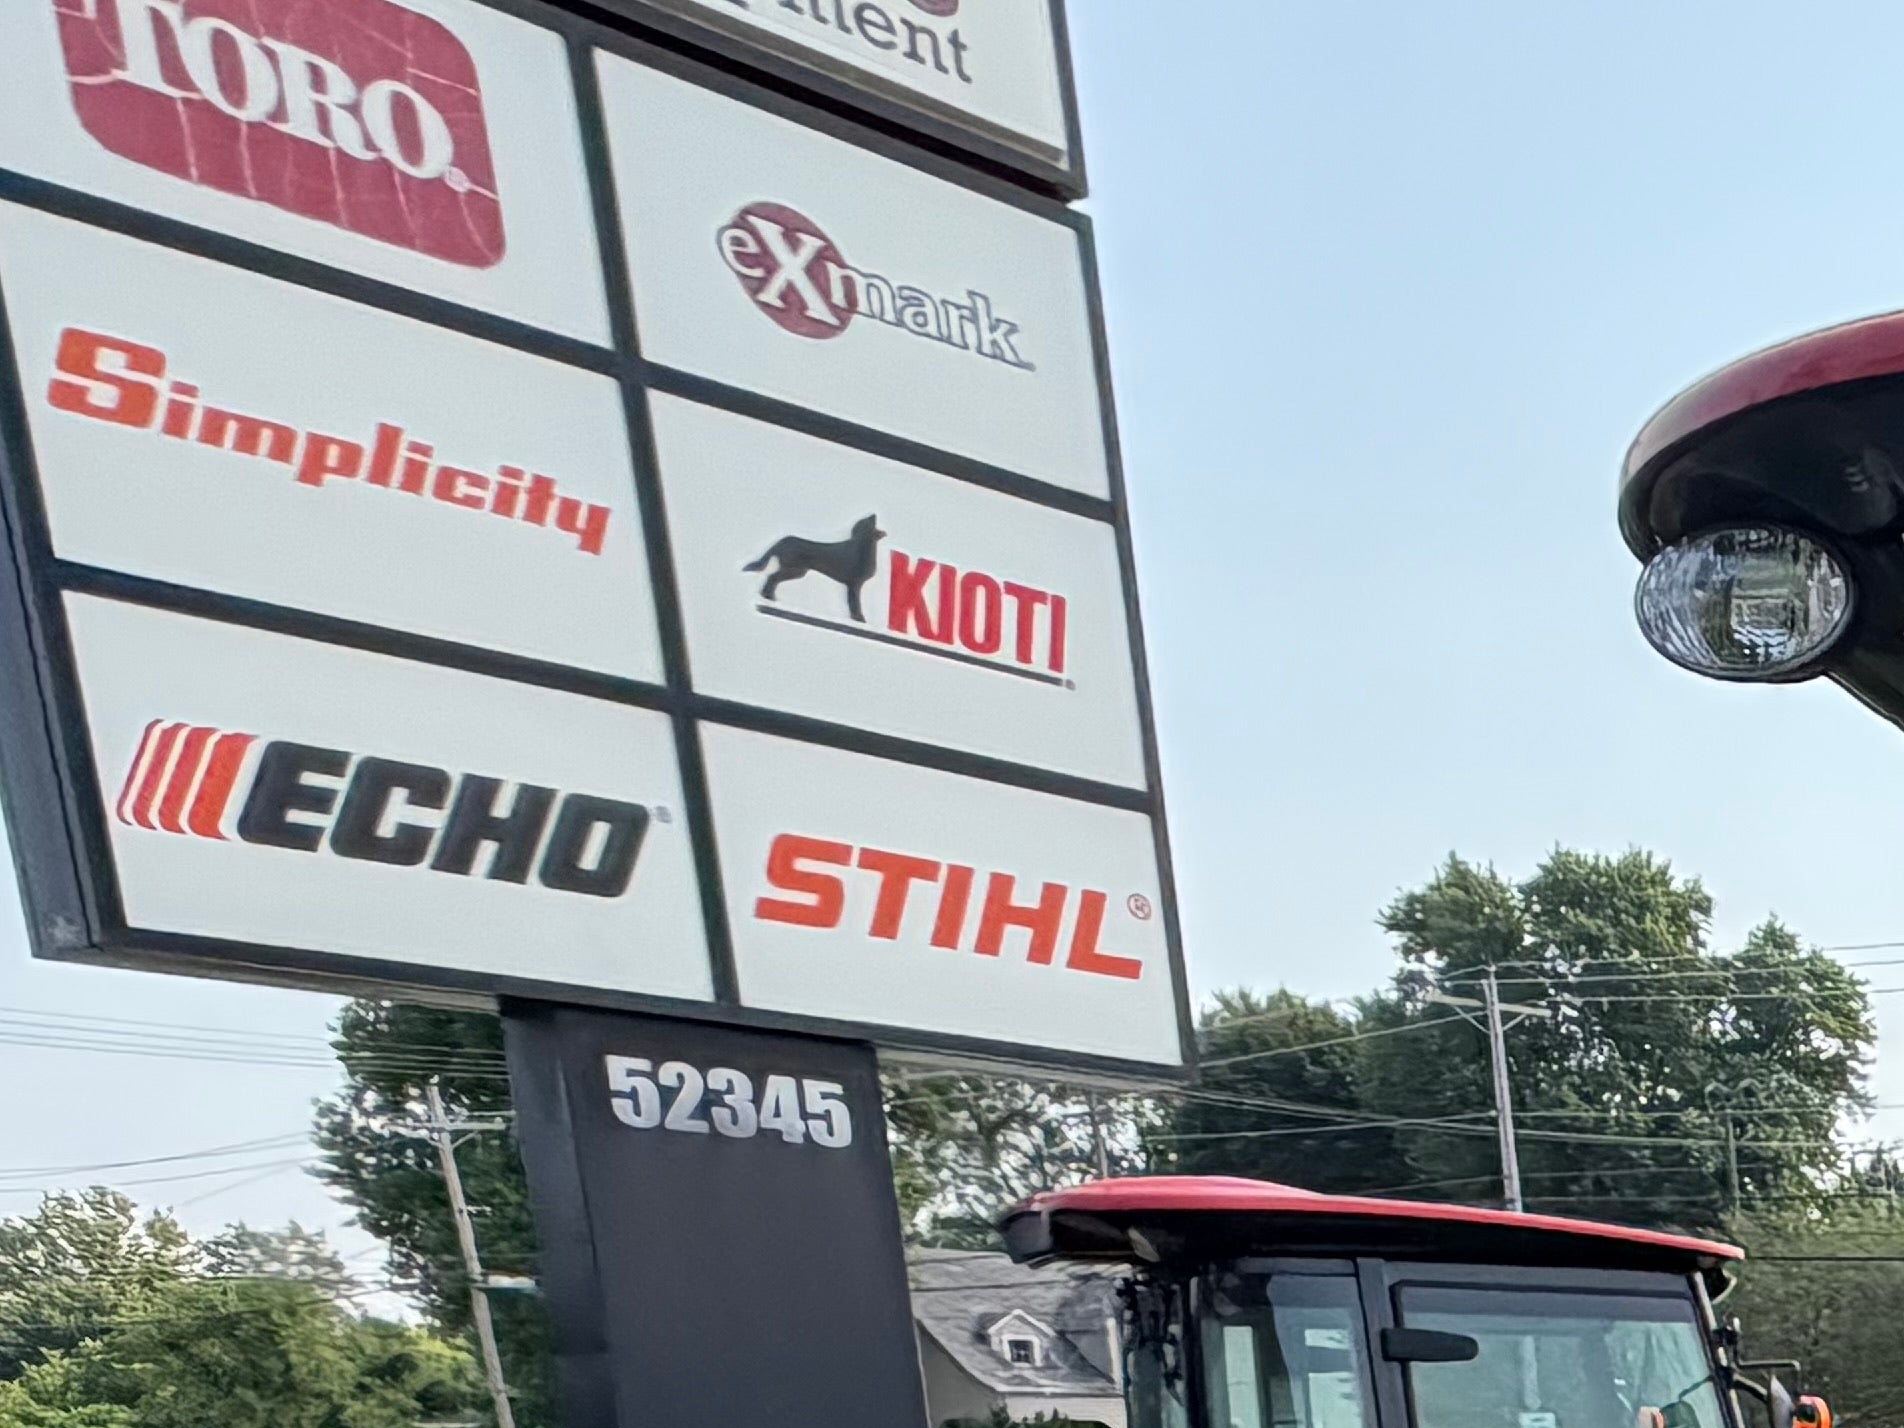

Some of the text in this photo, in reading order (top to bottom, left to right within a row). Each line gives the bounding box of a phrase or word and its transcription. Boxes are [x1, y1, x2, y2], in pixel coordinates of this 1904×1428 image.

[47, 326, 612, 556] Simplicity
[887, 549, 1067, 674] KIOTI
[235, 740, 652, 898] ECHO
[753, 833, 1143, 980] STIHL
[608, 1056, 852, 1150] 52345
